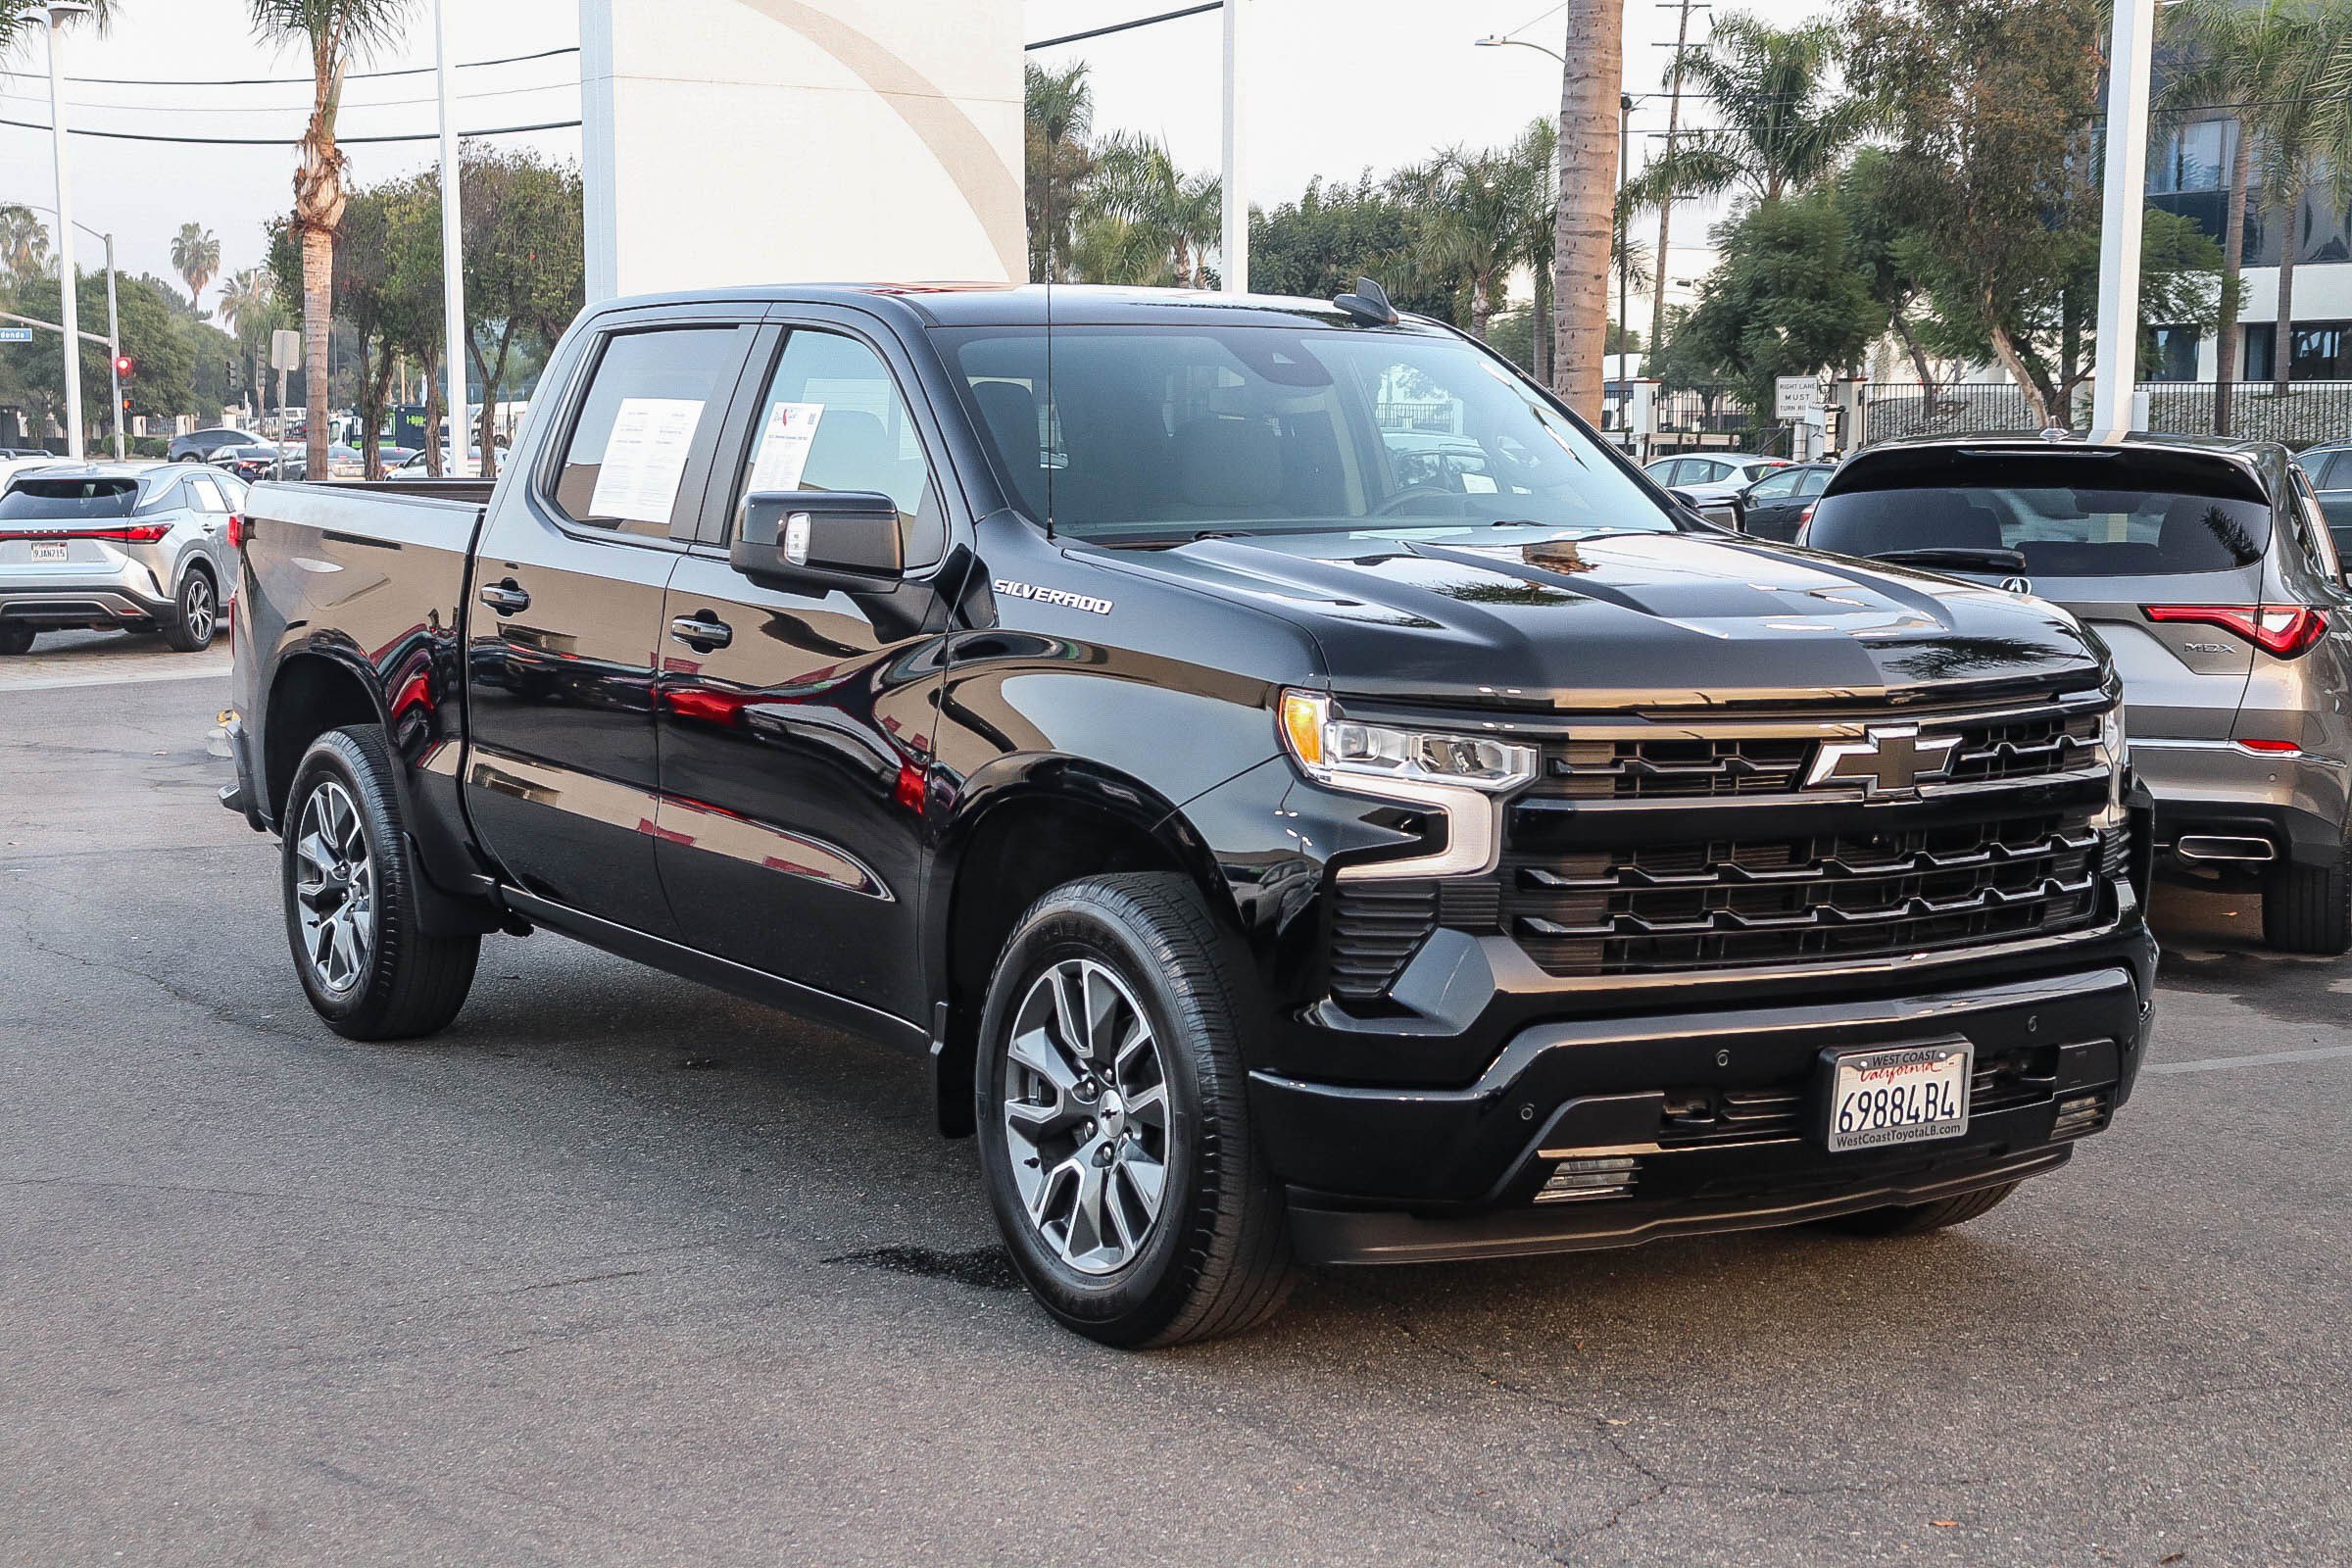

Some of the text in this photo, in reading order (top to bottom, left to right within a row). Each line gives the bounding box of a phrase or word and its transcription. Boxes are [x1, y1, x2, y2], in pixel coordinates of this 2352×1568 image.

[992, 578, 1113, 615] SILVERADO
[2183, 642, 2236, 654] MDX
[1872, 1050, 1936, 1067] WEST COAST
[1860, 1062, 1942, 1085] California
[1838, 1080, 1955, 1134] 69884B4
[1837, 1123, 1961, 1148] WestCoastToyotaLB.com
